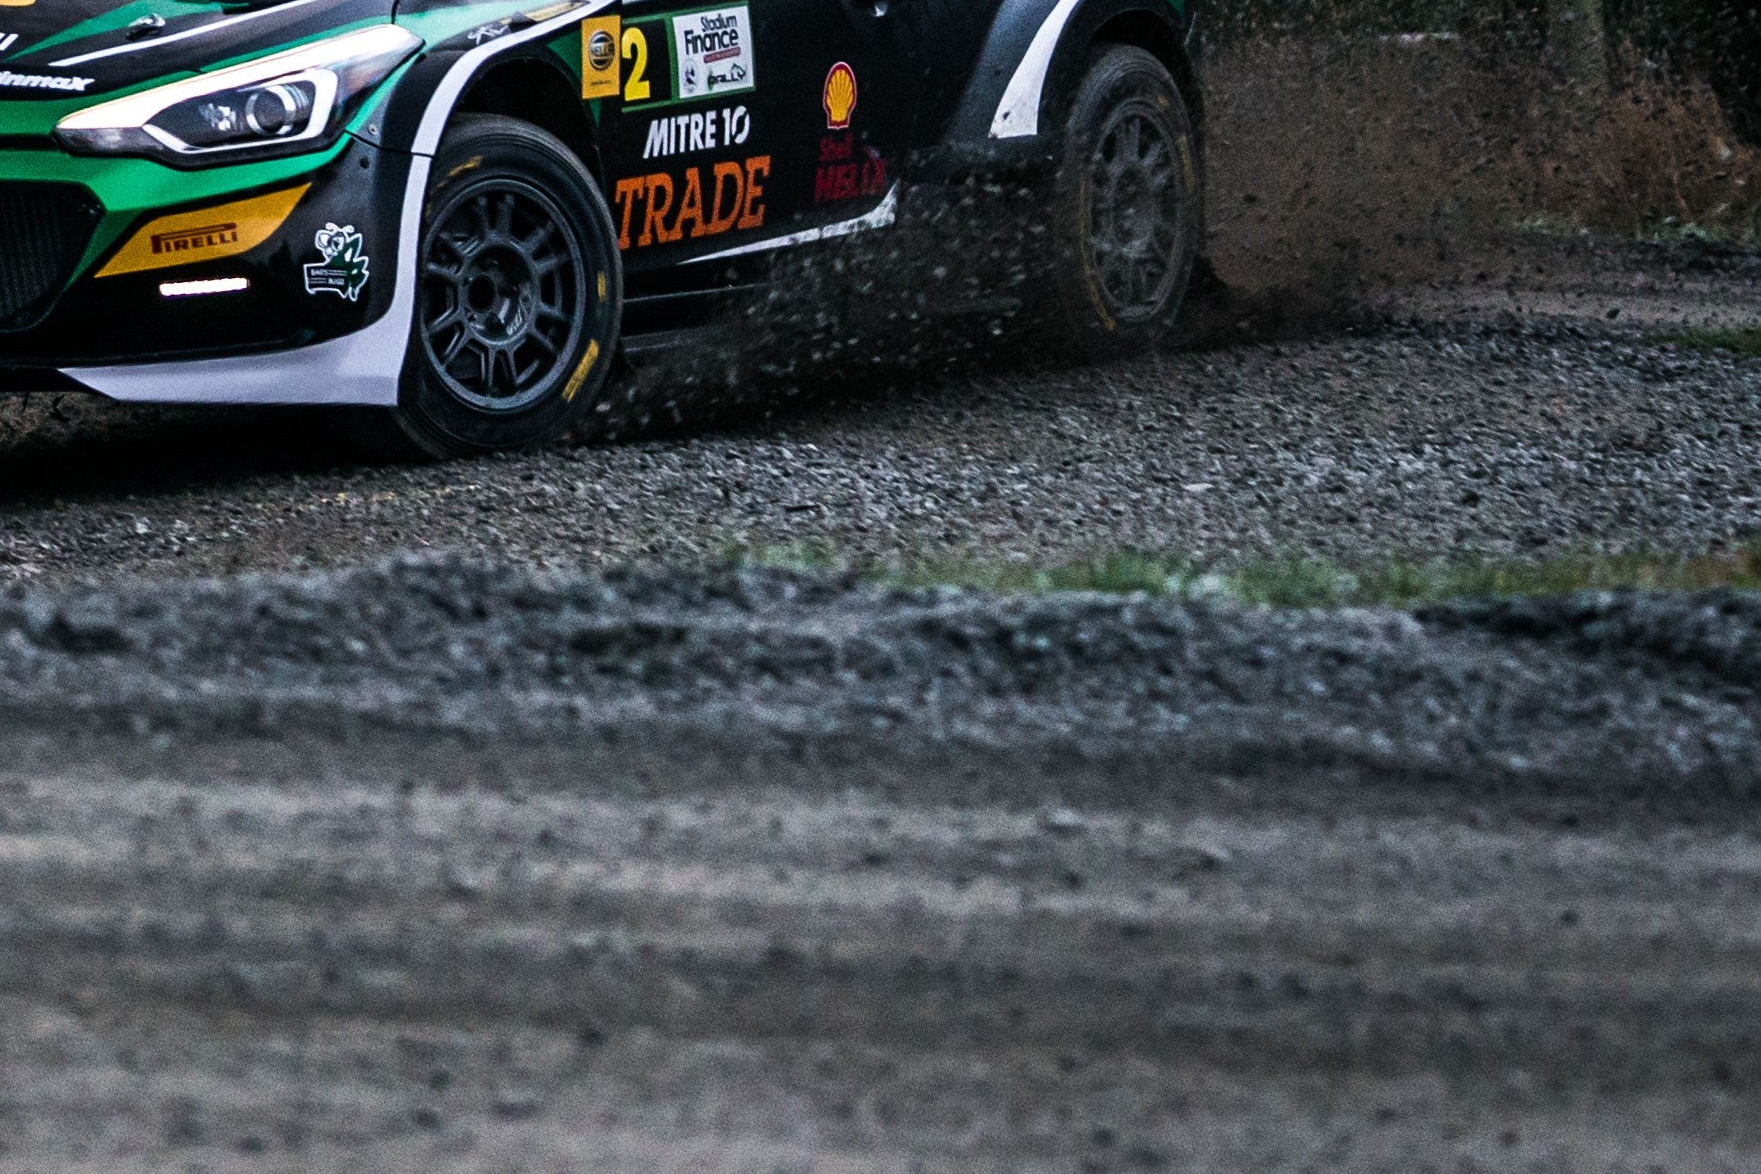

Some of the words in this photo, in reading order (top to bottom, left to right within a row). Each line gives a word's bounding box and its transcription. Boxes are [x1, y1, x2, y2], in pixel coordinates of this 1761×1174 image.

[684, 28, 739, 55] Finance
[700, 13, 738, 32] Stadium
[621, 27, 651, 101] 2
[643, 110, 716, 159] MITRE
[721, 105, 751, 145] 10
[615, 155, 771, 250] TRADE
[151, 222, 238, 254] PIRELLI
